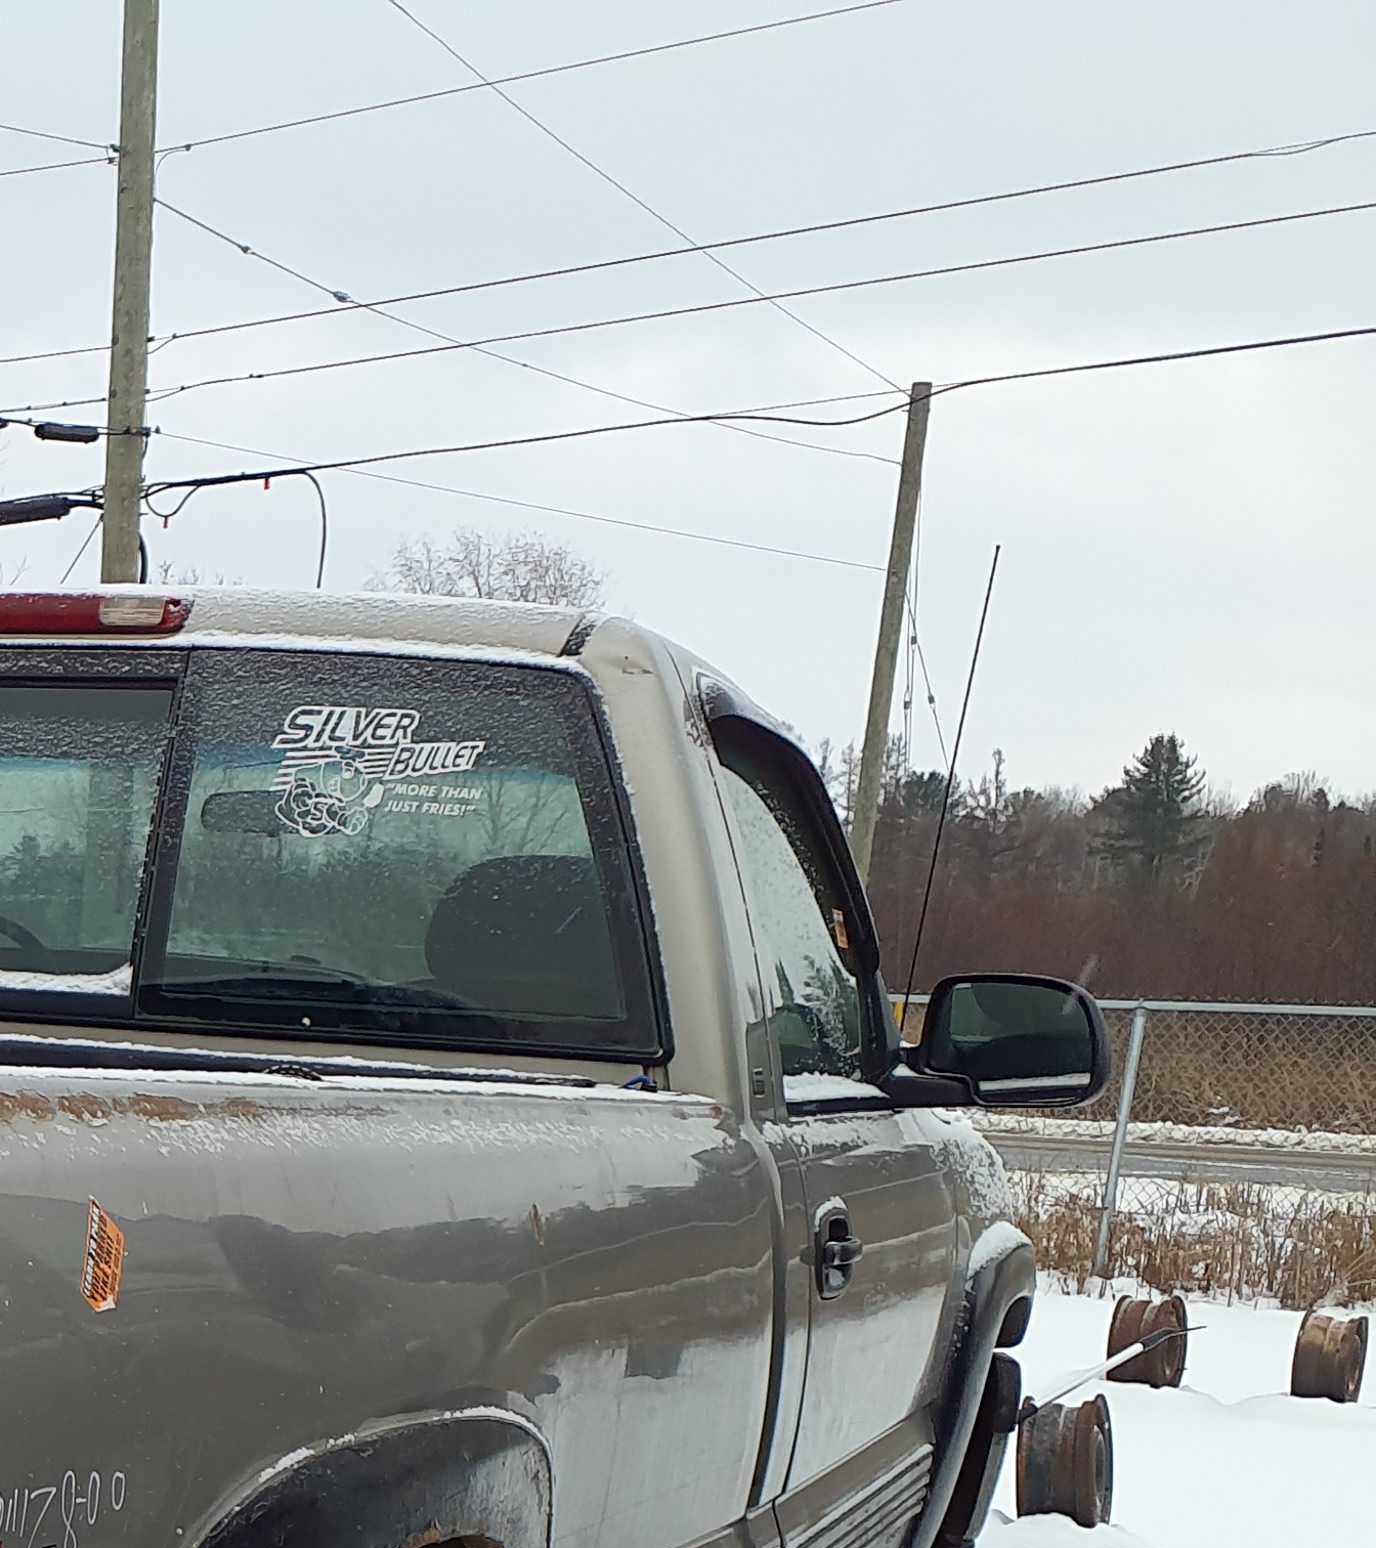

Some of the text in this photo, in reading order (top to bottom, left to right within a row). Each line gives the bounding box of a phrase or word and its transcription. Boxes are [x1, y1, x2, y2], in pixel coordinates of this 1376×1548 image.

[271, 705, 423, 749] SILVER
[383, 741, 486, 780] BULLET
[442, 785, 483, 800] THAN
[384, 800, 417, 813] JUST
